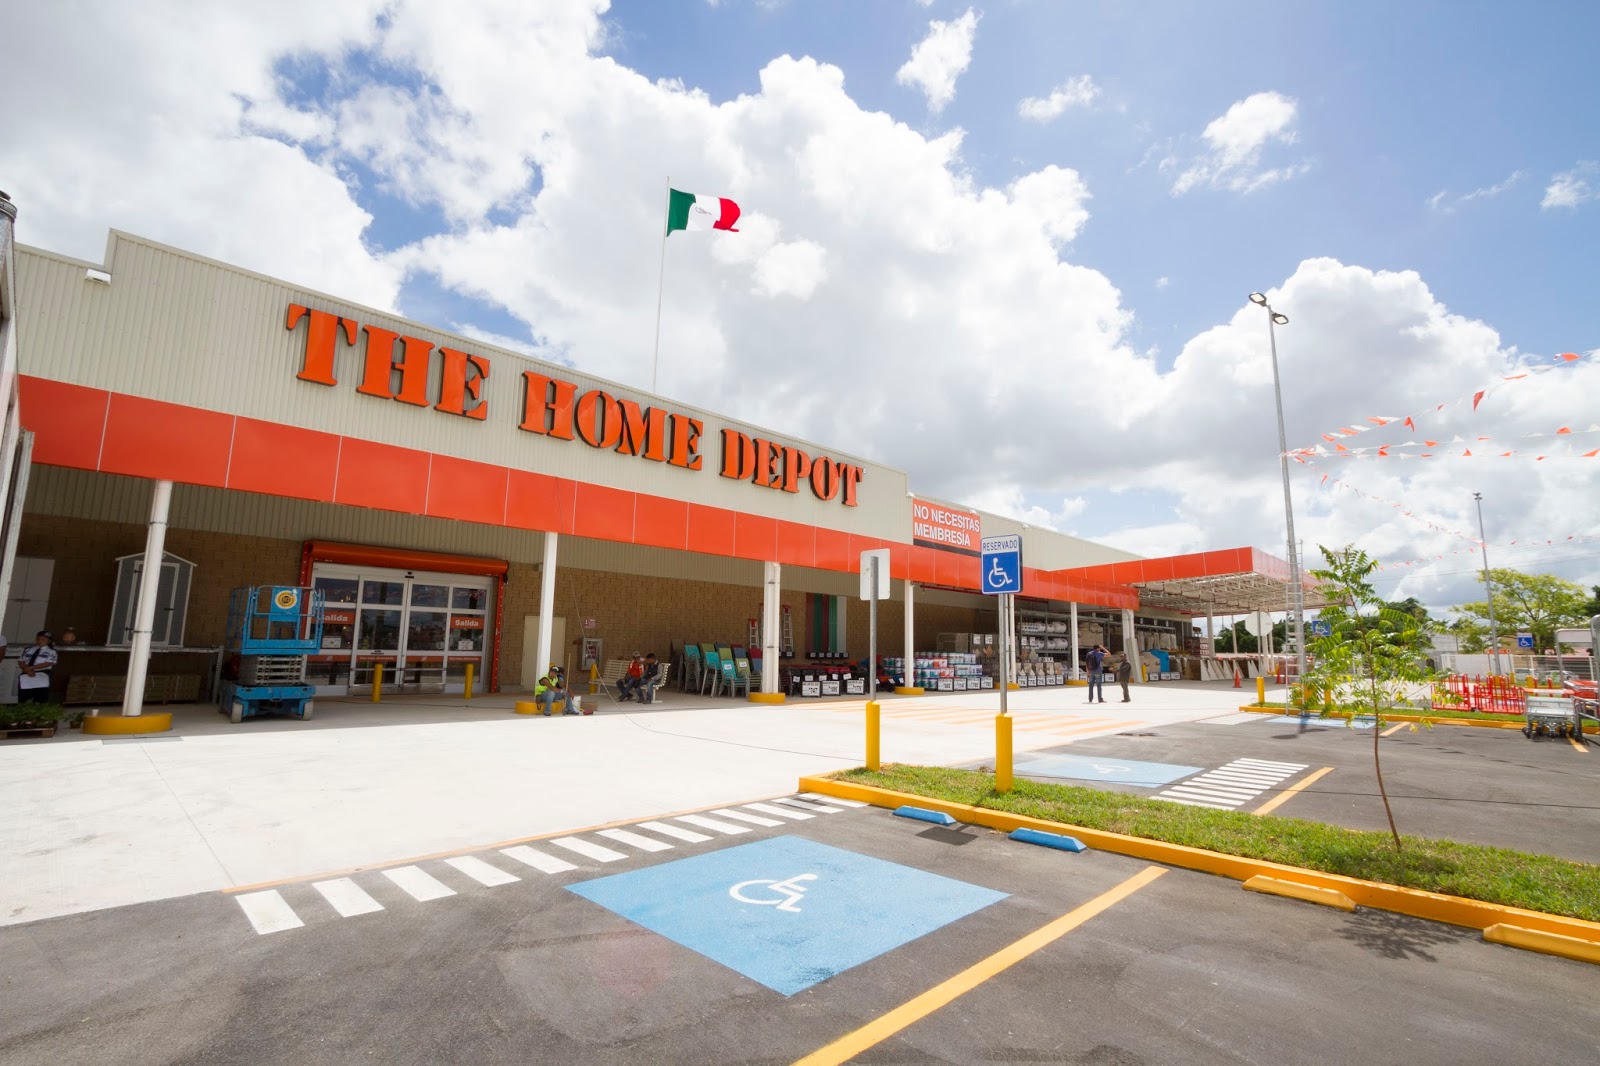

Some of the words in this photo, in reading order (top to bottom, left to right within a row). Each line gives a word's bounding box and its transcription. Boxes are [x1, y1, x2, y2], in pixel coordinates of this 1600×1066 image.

[286, 303, 491, 421] THE
[518, 371, 704, 472] HOME
[719, 428, 864, 508] DEPOT
[914, 504, 929, 519] NO
[931, 509, 980, 532] NECESITAS
[914, 522, 970, 546] MEMBRESÍA
[982, 540, 1018, 551] RESERVADO
[322, 614, 348, 622] alida
[455, 619, 479, 627] Salida
